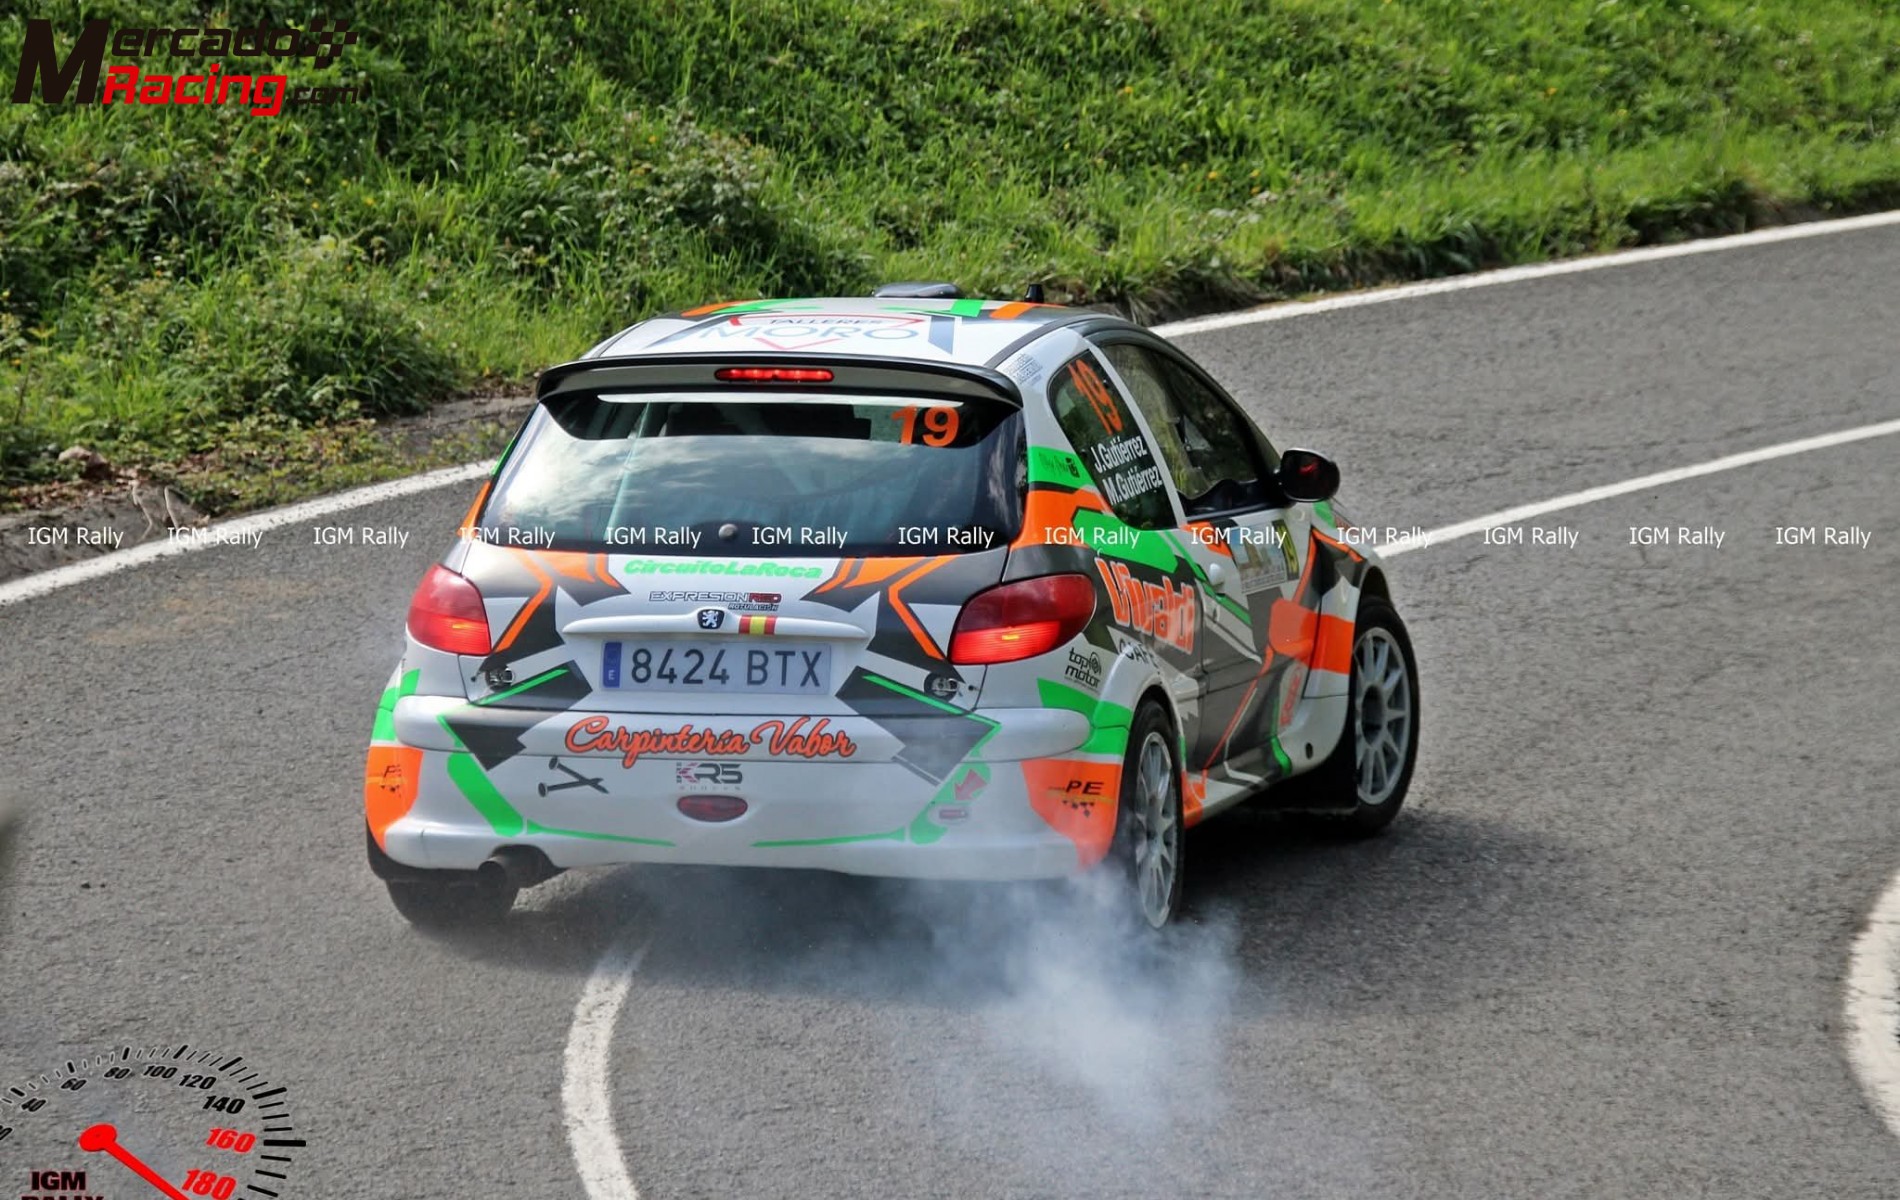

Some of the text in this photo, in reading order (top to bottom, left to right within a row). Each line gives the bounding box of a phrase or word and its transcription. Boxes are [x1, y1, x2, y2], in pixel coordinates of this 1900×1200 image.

[699, 325, 920, 341] MORO
[769, 318, 884, 326] TALLERES
[1067, 358, 1124, 436] 19
[891, 404, 960, 447] 19
[623, 560, 824, 579] CircuitoLaRoca
[631, 648, 822, 687] 8424 BTX
[1065, 665, 1101, 688] motor
[565, 716, 857, 769] Carpintería Vabor
[1066, 780, 1104, 795] PE
